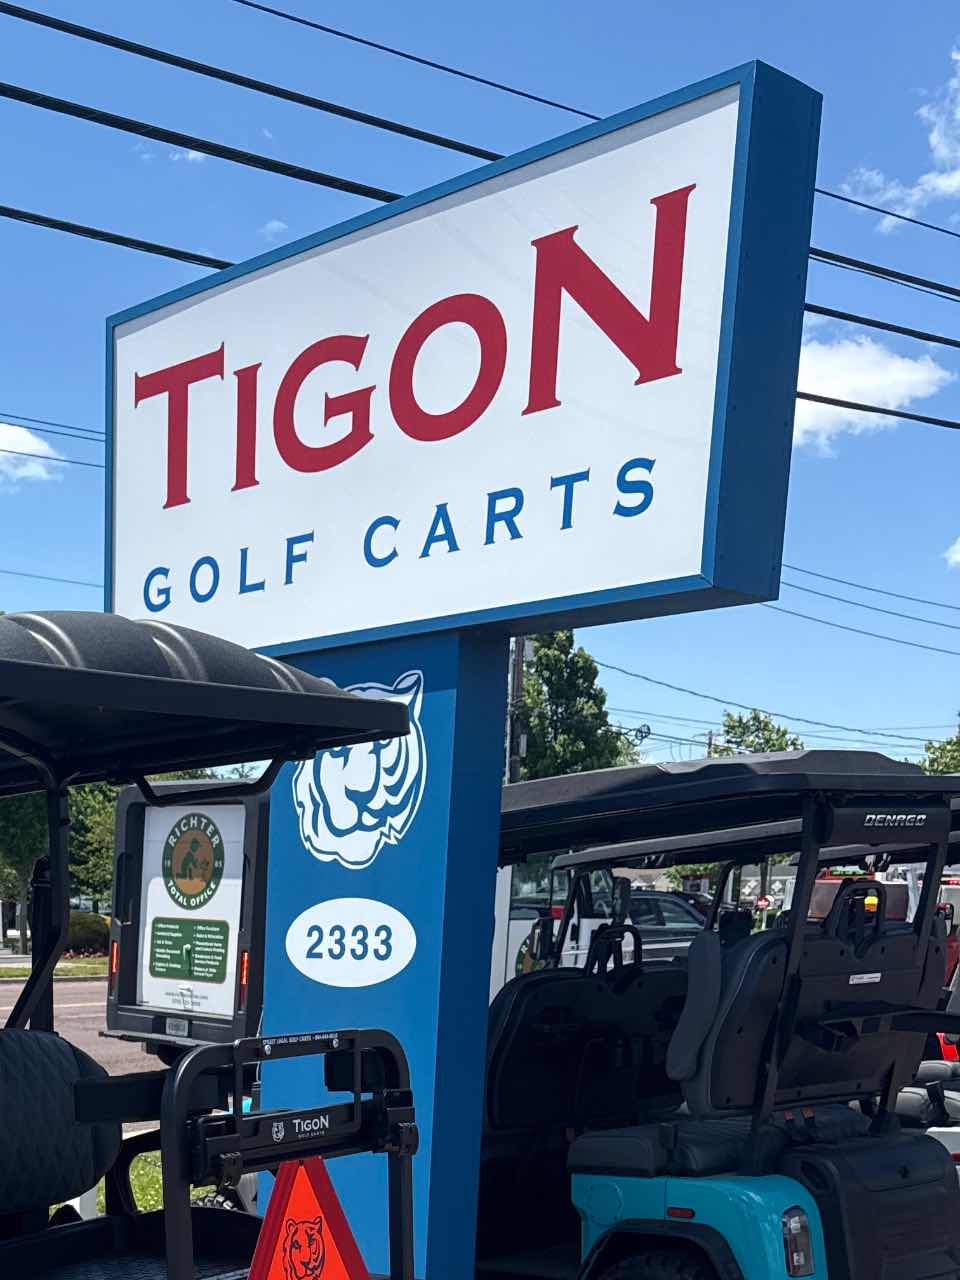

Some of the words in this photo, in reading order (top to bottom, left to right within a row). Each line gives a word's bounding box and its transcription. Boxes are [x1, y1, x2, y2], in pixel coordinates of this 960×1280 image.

[134, 183, 698, 511] TIGON
[143, 530, 315, 614] GOLF
[362, 457, 657, 569] CARTS
[168, 815, 220, 848] RICHTER
[167, 880, 187, 906] TOTAL
[190, 880, 217, 906] OFFICE
[305, 924, 393, 961] 2333
[292, 1114, 330, 1133] TIGON
